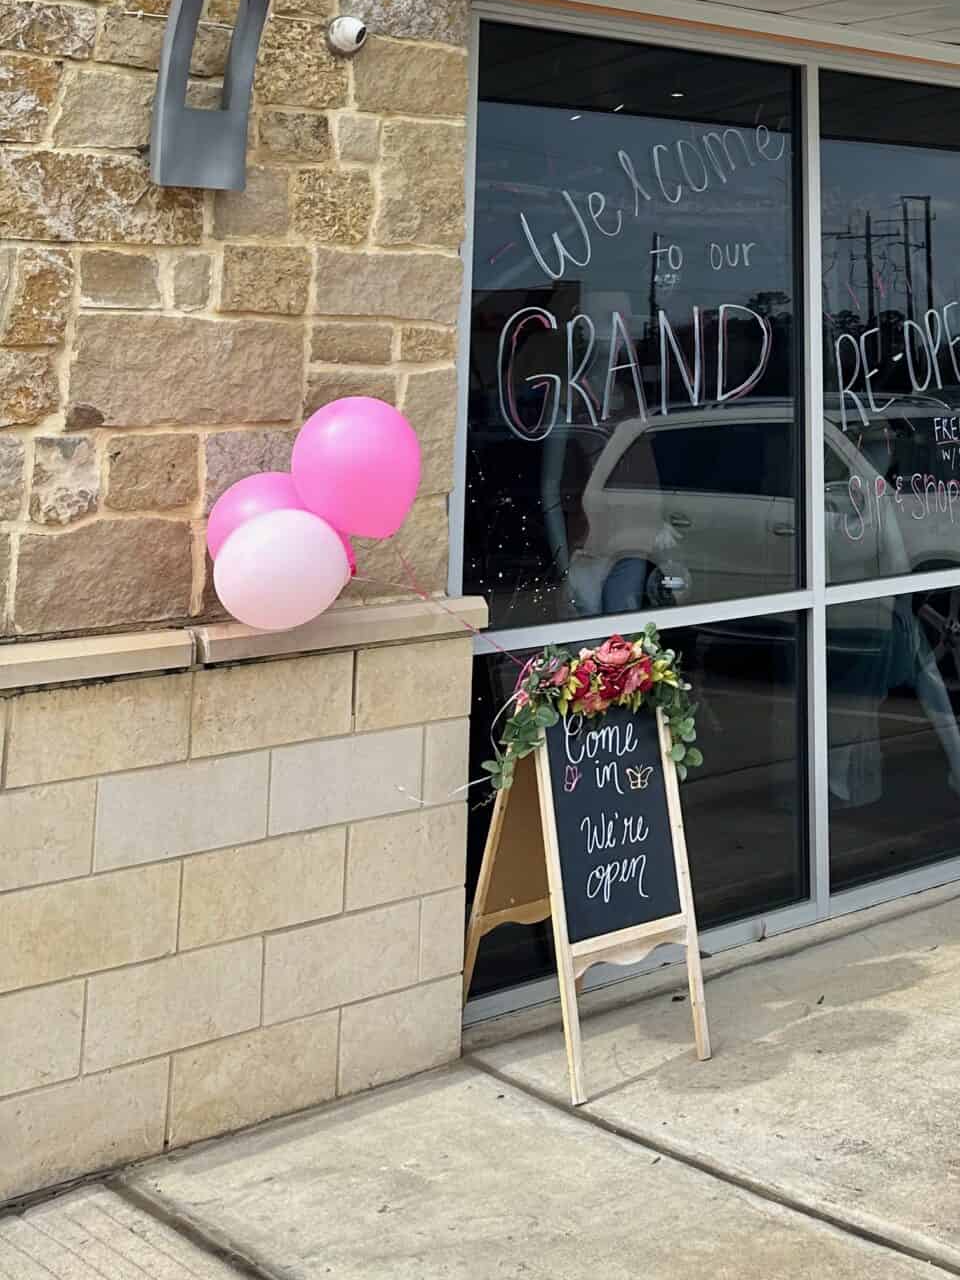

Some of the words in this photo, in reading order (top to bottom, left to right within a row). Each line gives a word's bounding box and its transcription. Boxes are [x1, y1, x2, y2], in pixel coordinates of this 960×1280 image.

[521, 125, 785, 279] Welcome
[649, 235, 683, 270] to
[710, 242, 756, 270] our
[498, 303, 772, 441] GRAND
[563, 715, 638, 763] Come
[595, 760, 624, 794] in
[581, 812, 648, 854] We're
[587, 854, 648, 903] open
